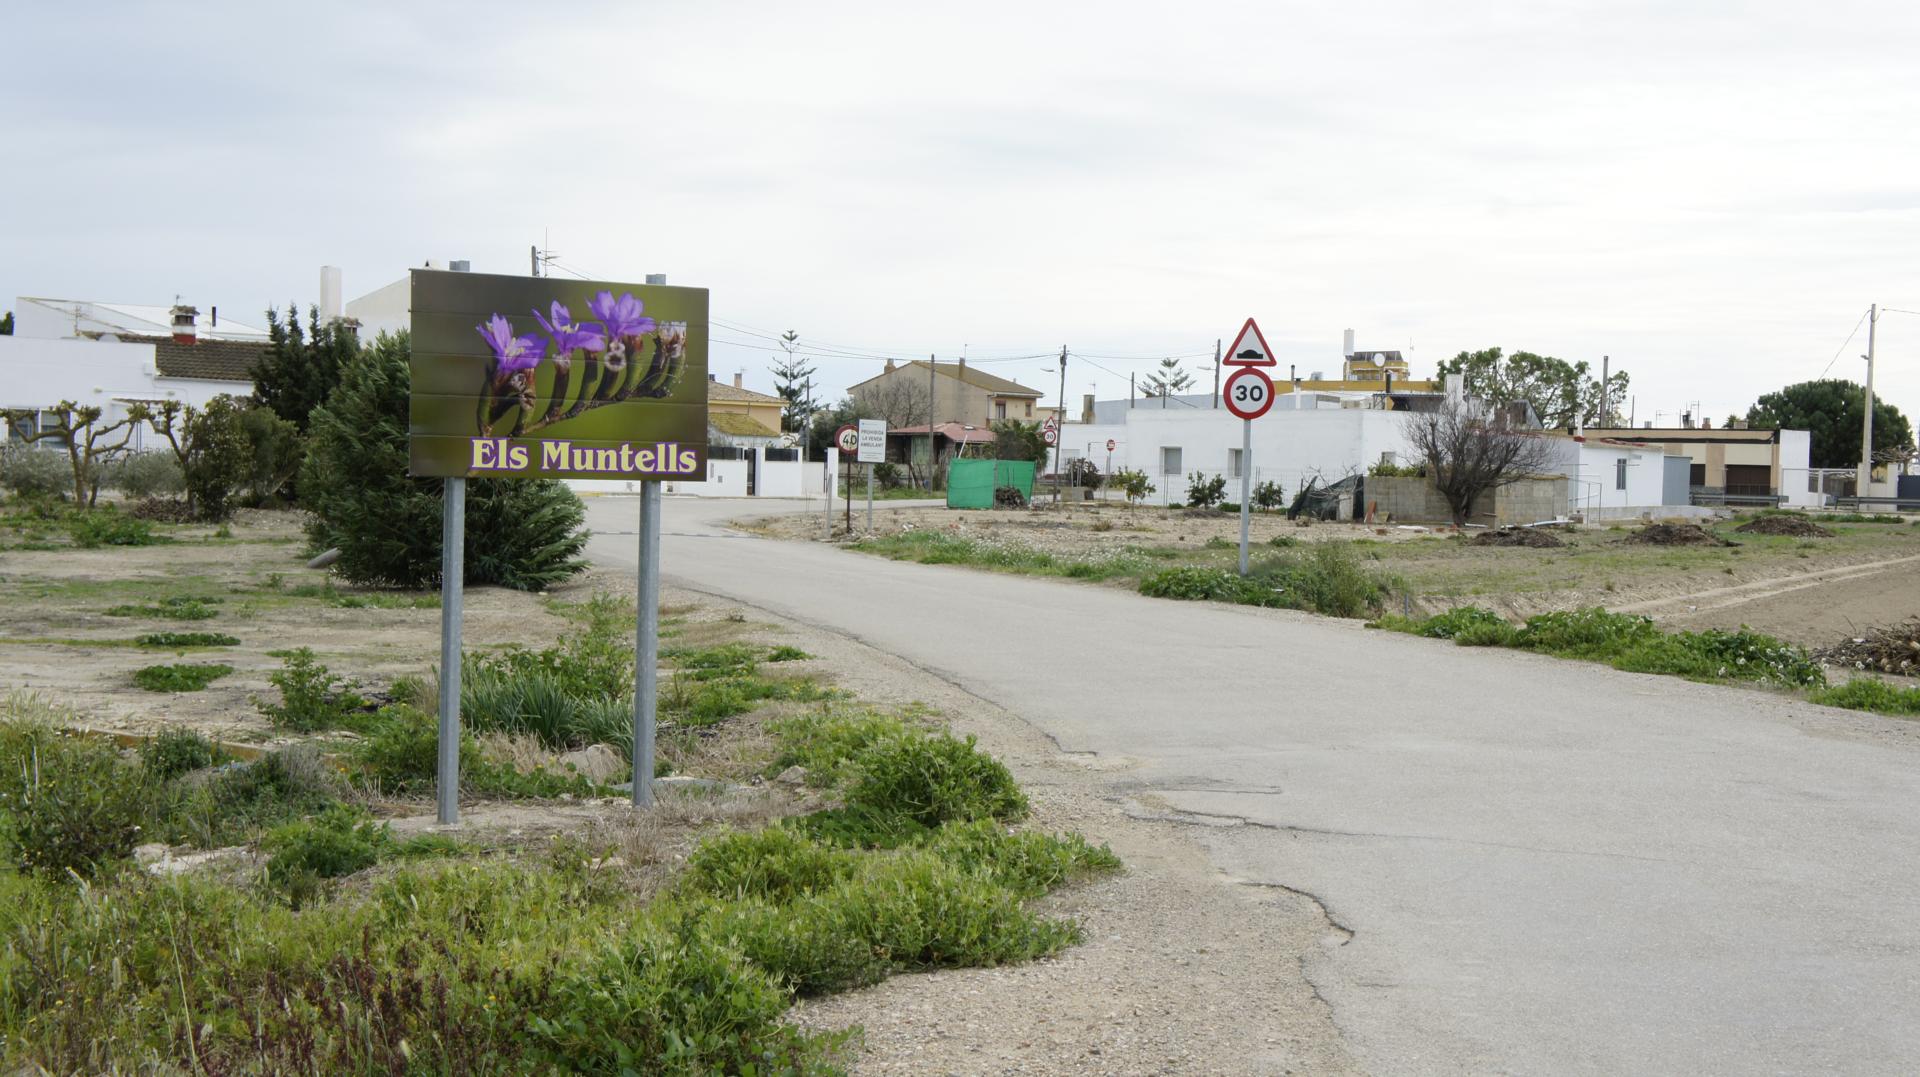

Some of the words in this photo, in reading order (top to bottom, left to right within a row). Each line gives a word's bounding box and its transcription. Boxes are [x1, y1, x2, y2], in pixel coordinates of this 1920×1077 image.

[1235, 384, 1263, 402] 30
[470, 438, 530, 471] Els
[541, 440, 698, 473] Muntells
